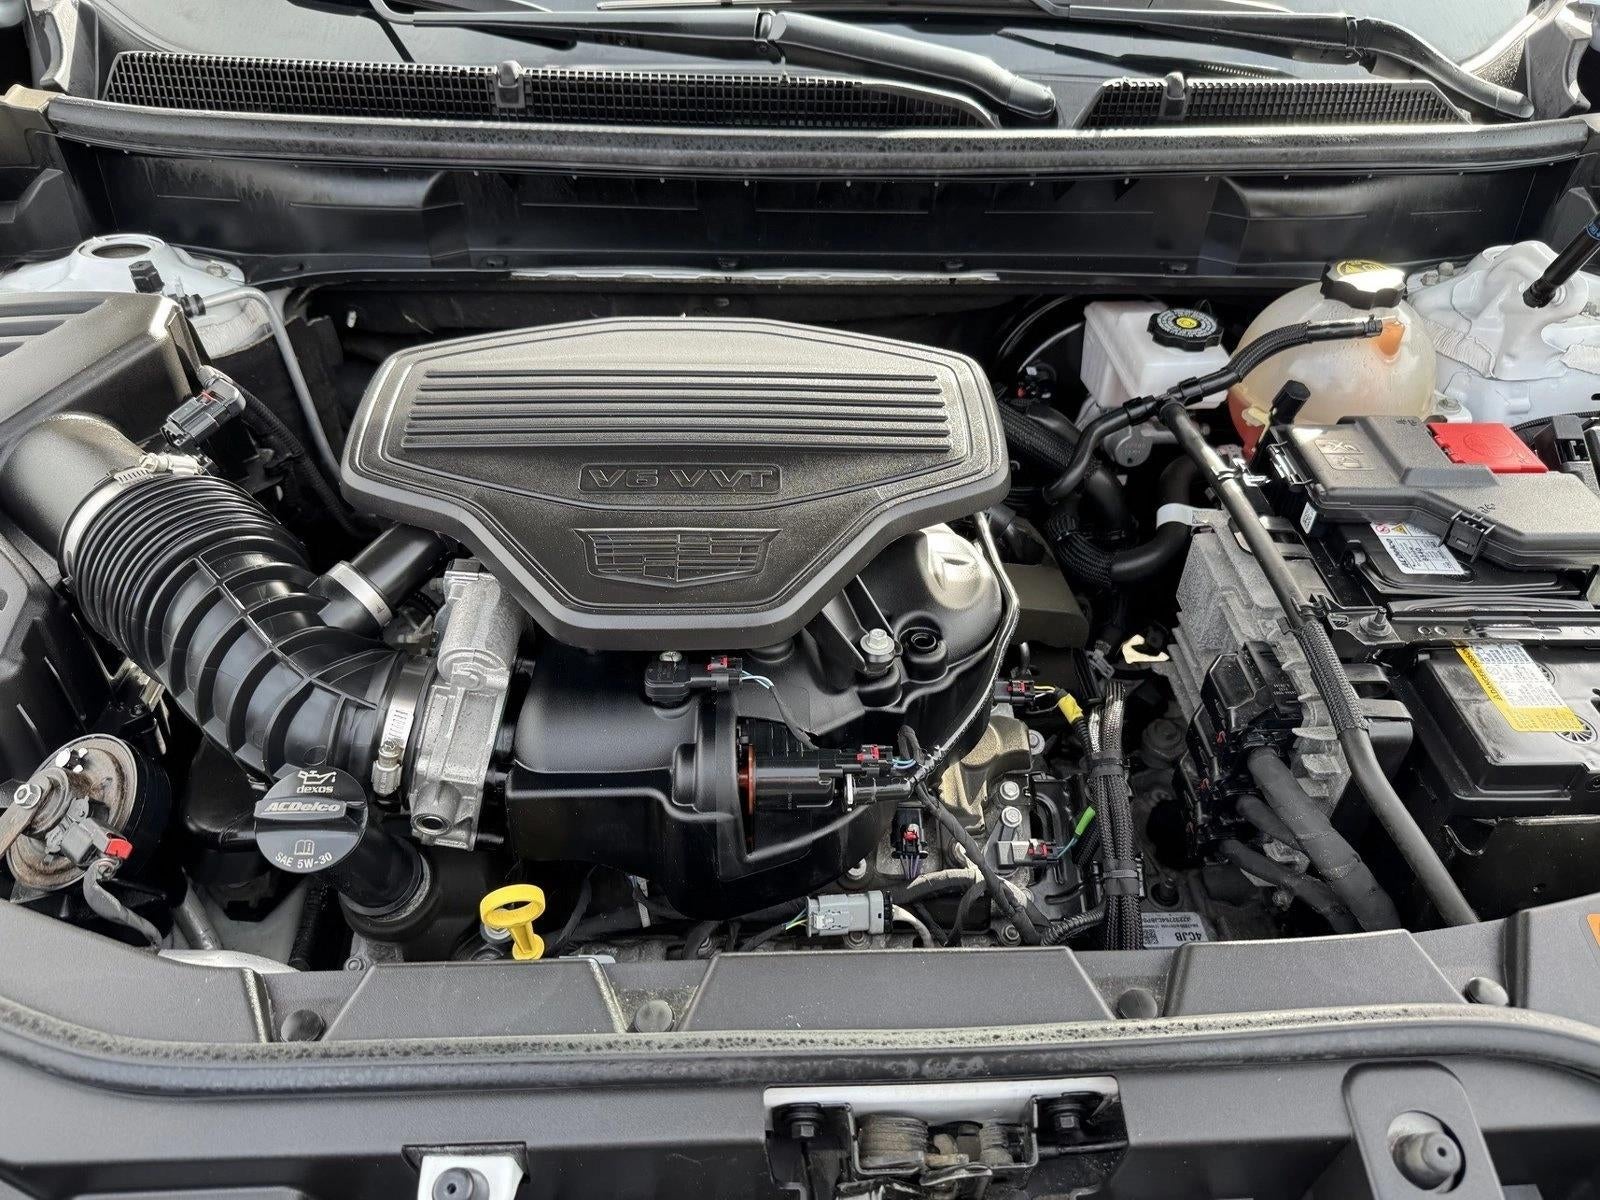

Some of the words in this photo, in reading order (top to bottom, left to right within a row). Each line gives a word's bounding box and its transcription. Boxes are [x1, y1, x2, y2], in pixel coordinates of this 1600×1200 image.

[589, 469, 659, 488] V6
[670, 469, 772, 488] VVT
[296, 785, 334, 794] dexos
[264, 801, 341, 812] ACDelco
[275, 851, 293, 867] SAE
[297, 852, 332, 868] 5W-30
[1175, 931, 1202, 942] 4CJB
